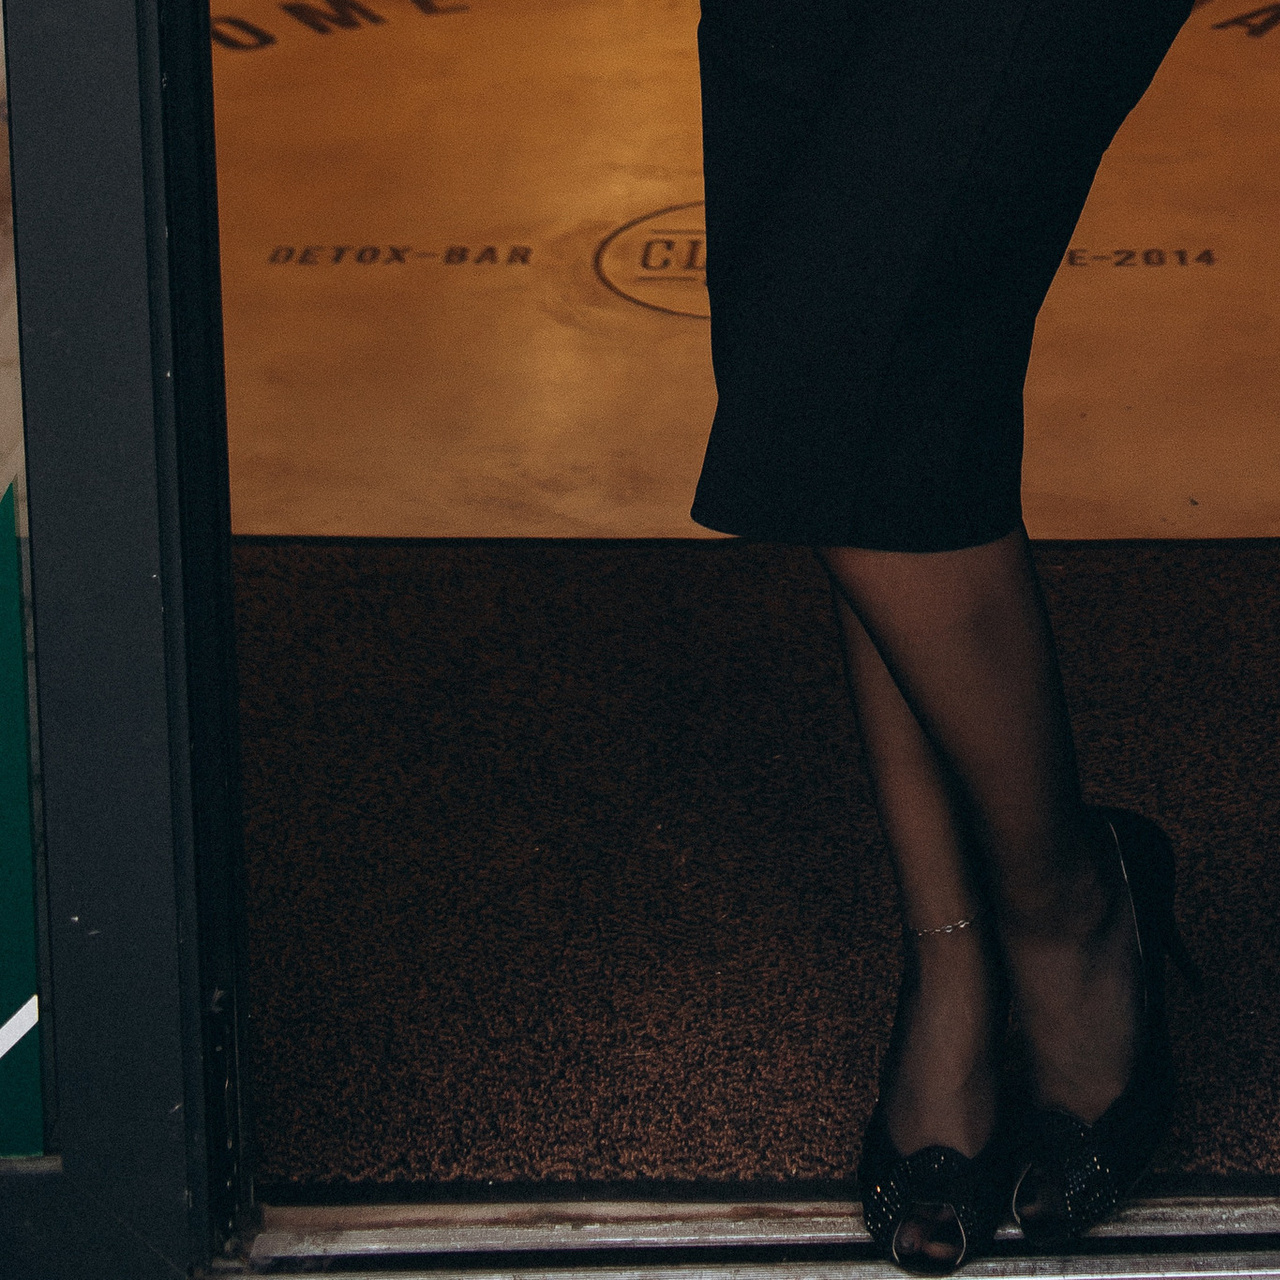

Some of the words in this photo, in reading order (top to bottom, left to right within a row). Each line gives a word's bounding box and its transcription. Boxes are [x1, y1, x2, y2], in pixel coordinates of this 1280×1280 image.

[267, 245, 533, 266] DETOX-BAR
[639, 238, 705, 271] CL
[1066, 248, 1217, 268] E-2014
